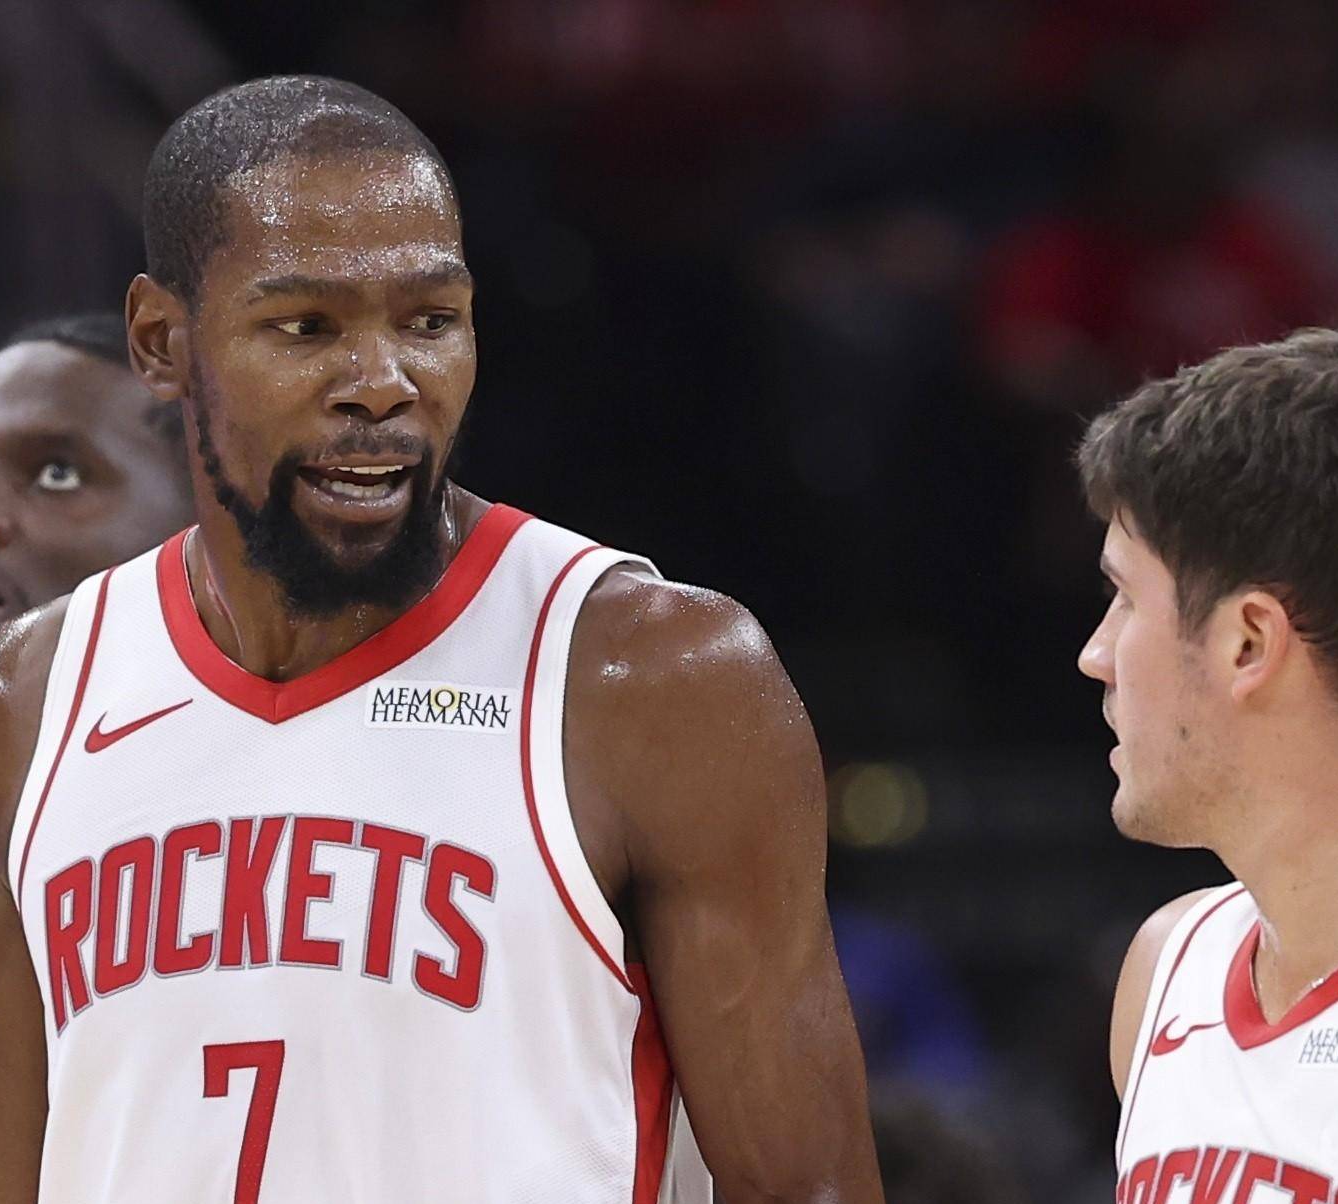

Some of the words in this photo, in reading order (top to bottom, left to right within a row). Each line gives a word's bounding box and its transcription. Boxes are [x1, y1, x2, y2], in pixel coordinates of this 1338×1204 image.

[373, 687, 511, 712] MEMORIAL
[370, 704, 508, 728] HERMANN
[44, 812, 497, 1038] ROCKETS
